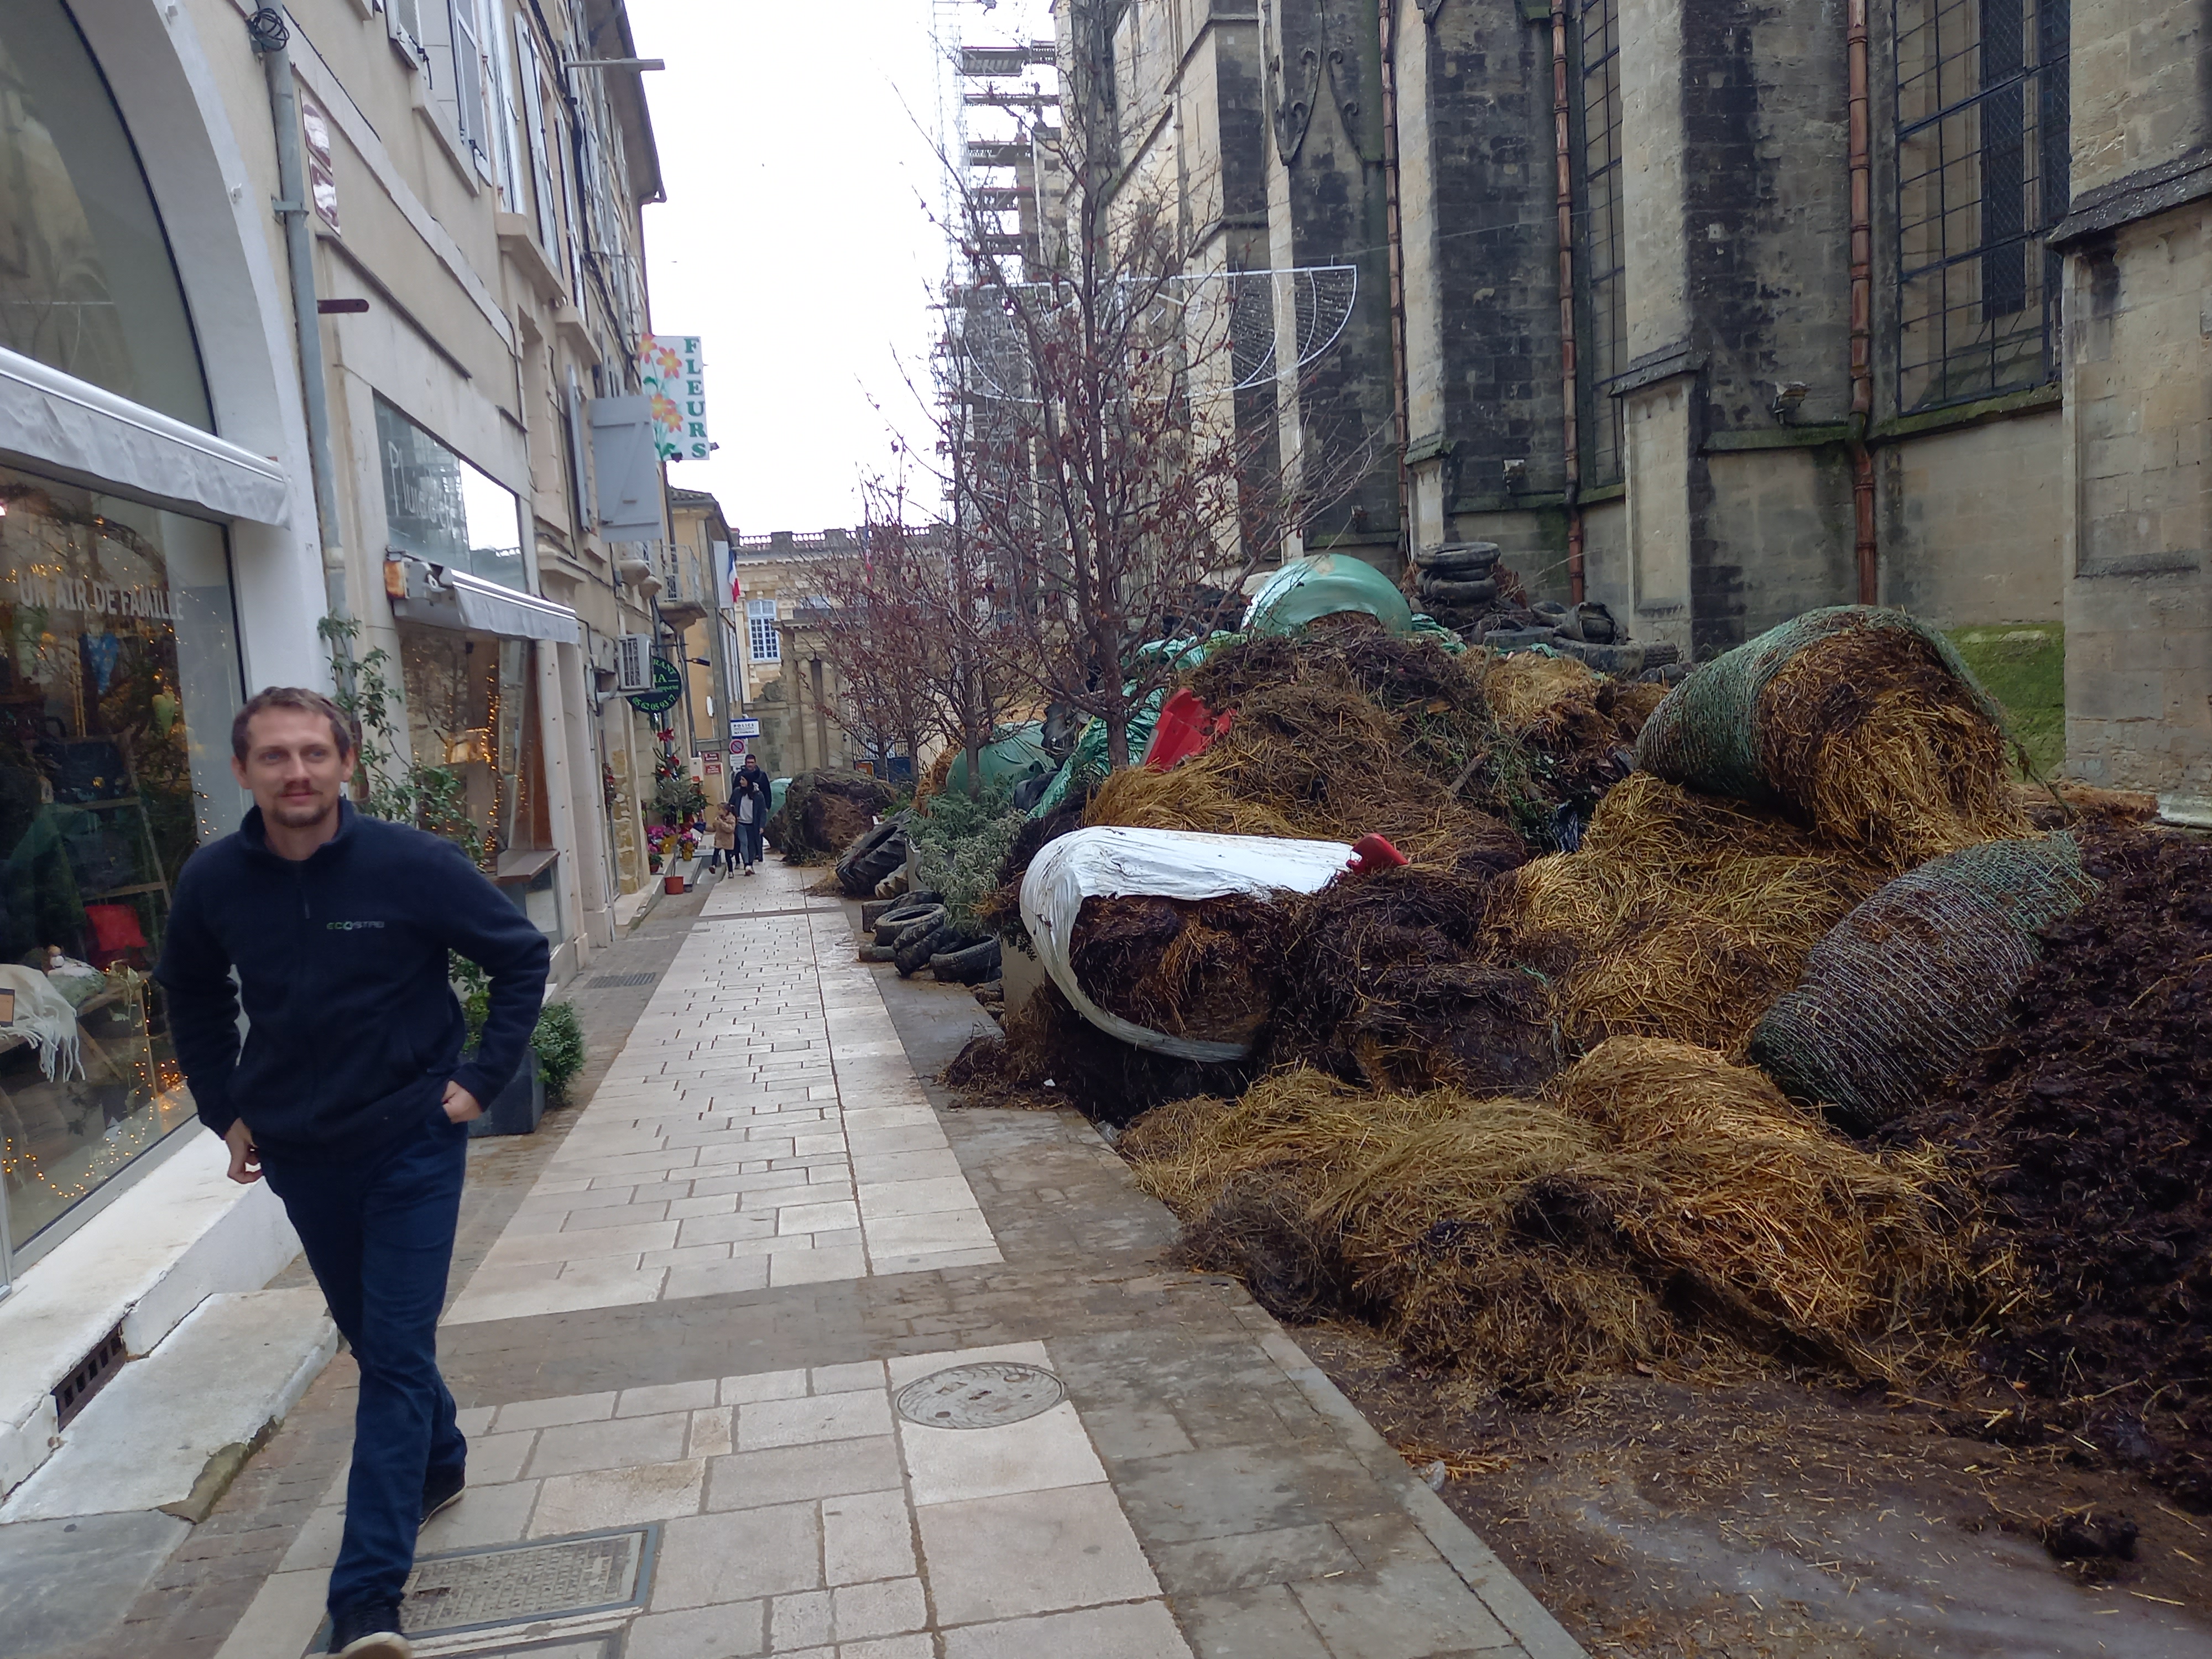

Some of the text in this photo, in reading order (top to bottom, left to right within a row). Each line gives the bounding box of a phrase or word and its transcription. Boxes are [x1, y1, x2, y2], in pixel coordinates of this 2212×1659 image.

[684, 338, 707, 458] FLEURS
[18, 572, 184, 620] UN AIR DE FAMILLE
